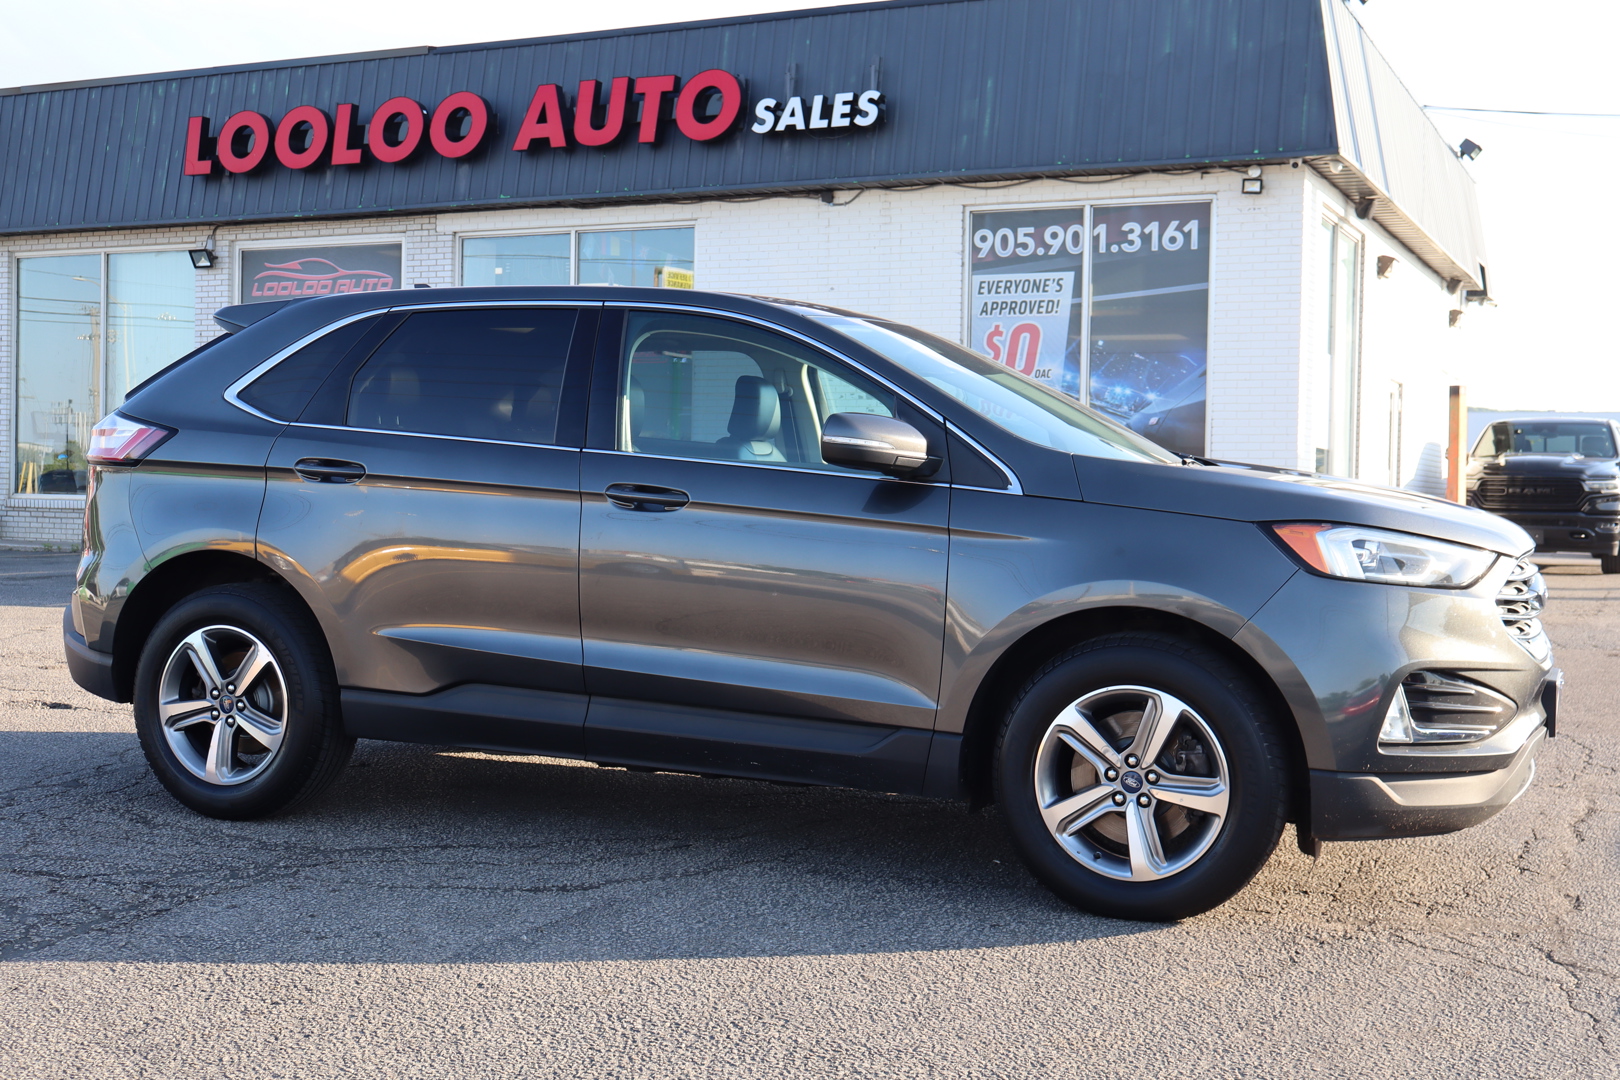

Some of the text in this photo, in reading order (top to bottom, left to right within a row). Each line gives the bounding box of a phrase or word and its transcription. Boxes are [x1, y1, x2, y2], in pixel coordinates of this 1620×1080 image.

[184, 68, 883, 177] LOOLOO AUTO SALES
[973, 219, 1200, 259] 905.901.3161
[251, 277, 394, 297] LOOLOO AUTO
[977, 277, 1064, 296] EVERYONE'S
[979, 299, 1060, 317] APPROVED!
[985, 324, 1041, 377] $0
[1034, 368, 1053, 379] OAC
